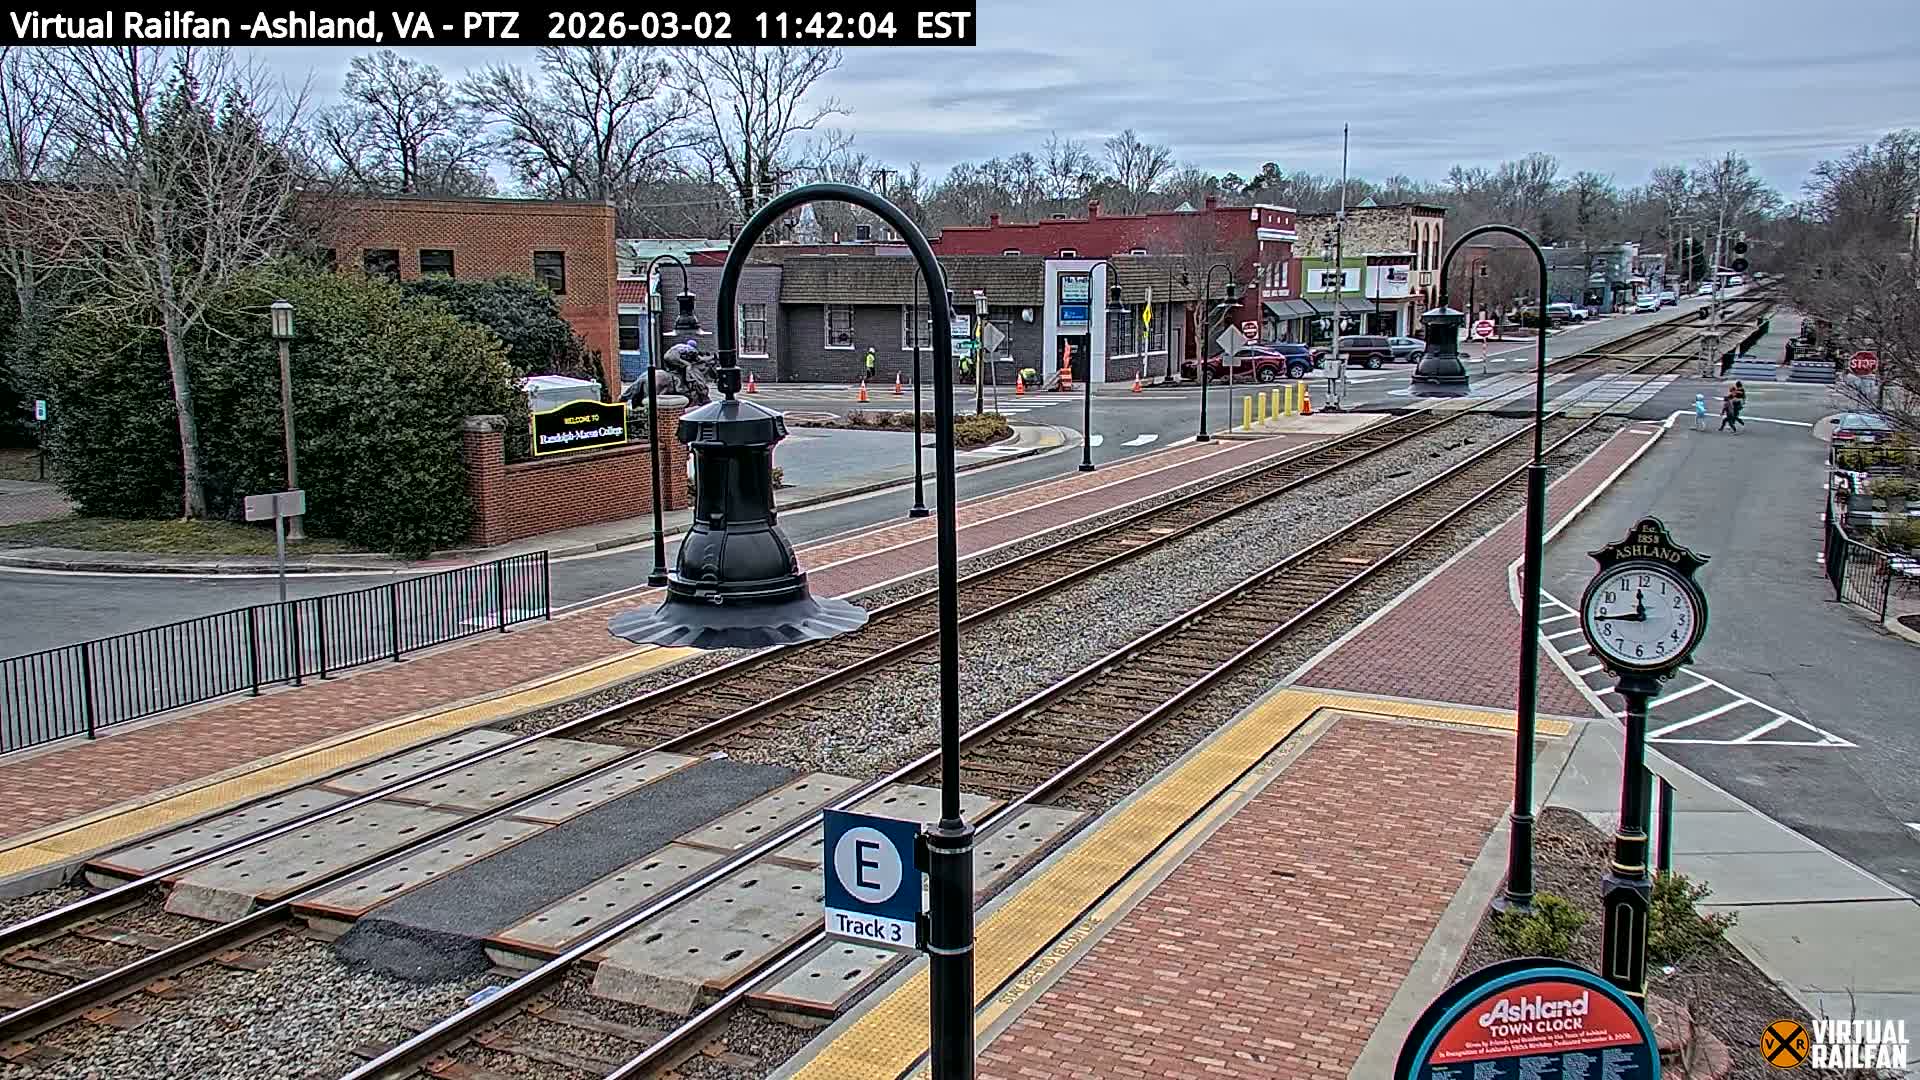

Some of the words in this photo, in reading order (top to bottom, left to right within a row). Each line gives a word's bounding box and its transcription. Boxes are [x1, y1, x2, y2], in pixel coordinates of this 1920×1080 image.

[1850, 358, 1876, 369] STOP
[564, 415, 591, 424] WELCOME
[599, 426, 623, 437] College
[1616, 544, 1681, 563] ASHLAND
[1621, 578, 1630, 591] 11
[1638, 576, 1650, 588] 12
[1604, 592, 1617, 604] 10
[1673, 596, 1682, 609] 2
[1678, 614, 1686, 626] 3
[1602, 623, 1612, 637] 8
[1671, 630, 1680, 642] 4
[1615, 638, 1624, 651] 7
[1635, 644, 1644, 657] 6
[1656, 642, 1665, 655] 5
[855, 840, 881, 890] E
[836, 913, 886, 940] Track
[890, 923, 902, 942] 3
[1478, 990, 1589, 1028] Ashland
[1490, 1023, 1533, 1038] TOWN
[1536, 1018, 1583, 1033] CLOCK
